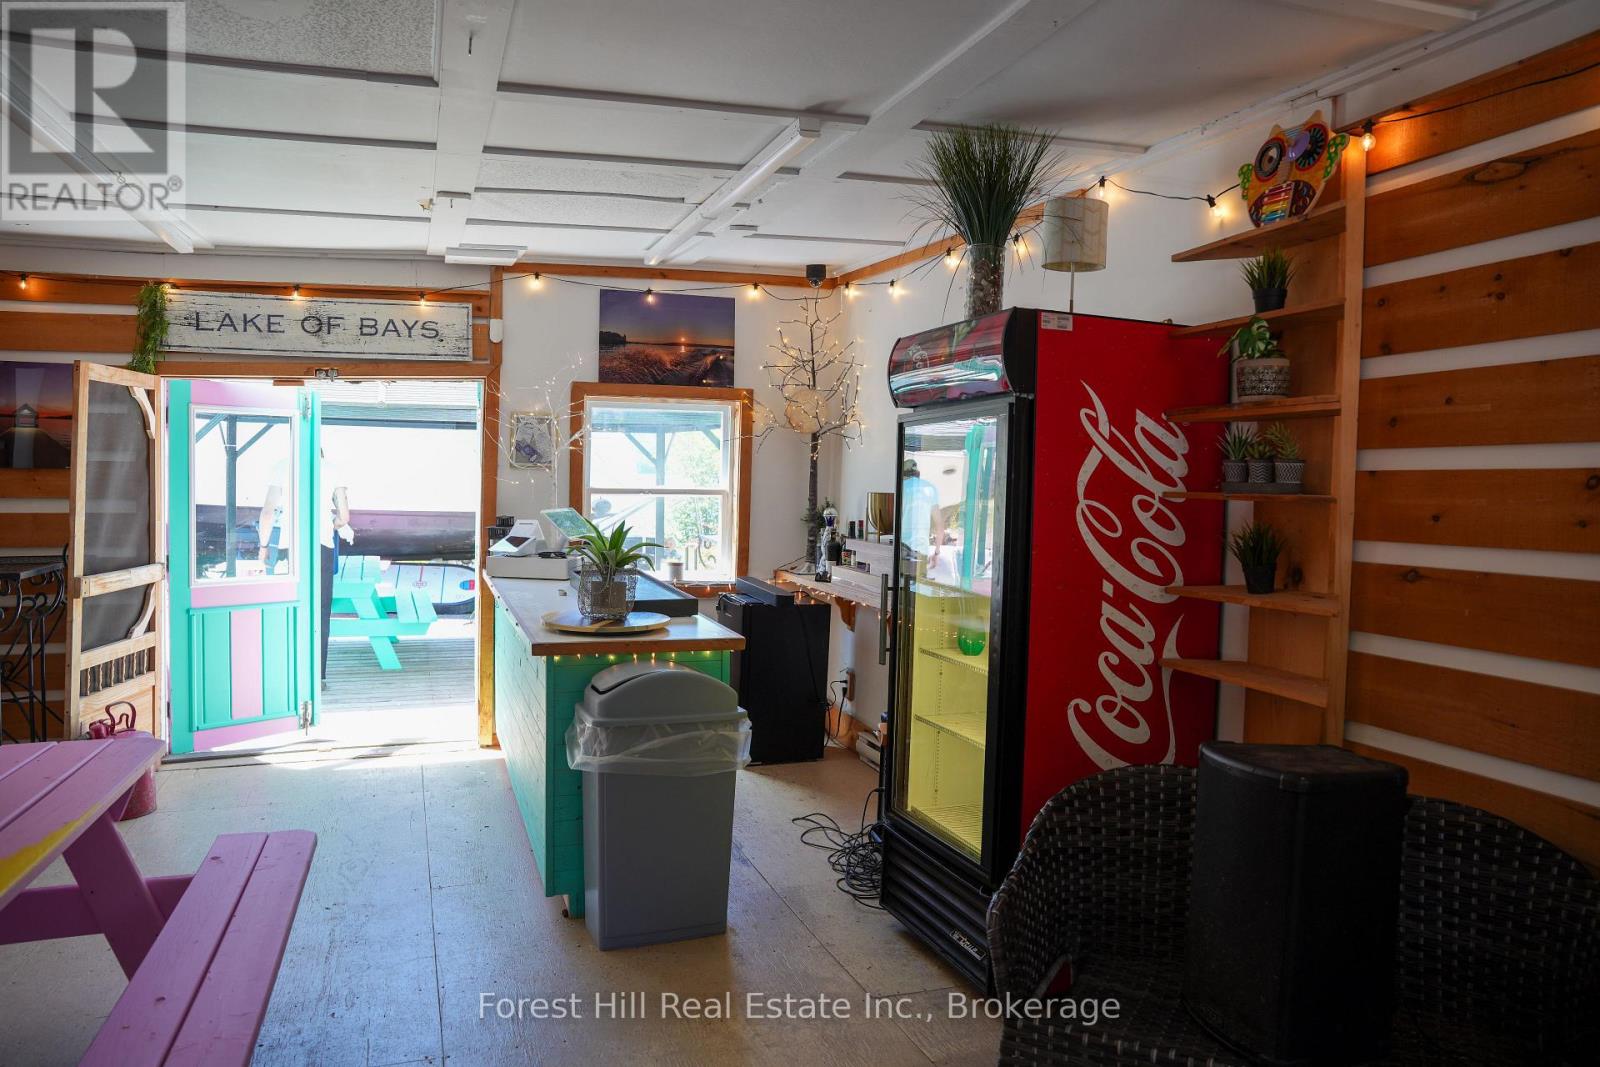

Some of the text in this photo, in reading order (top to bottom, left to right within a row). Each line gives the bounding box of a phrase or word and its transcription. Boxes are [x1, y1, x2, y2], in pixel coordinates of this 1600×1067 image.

[194, 310, 440, 339] LAKE OF BAYS
[1066, 379, 1190, 771] Coca-Cola
